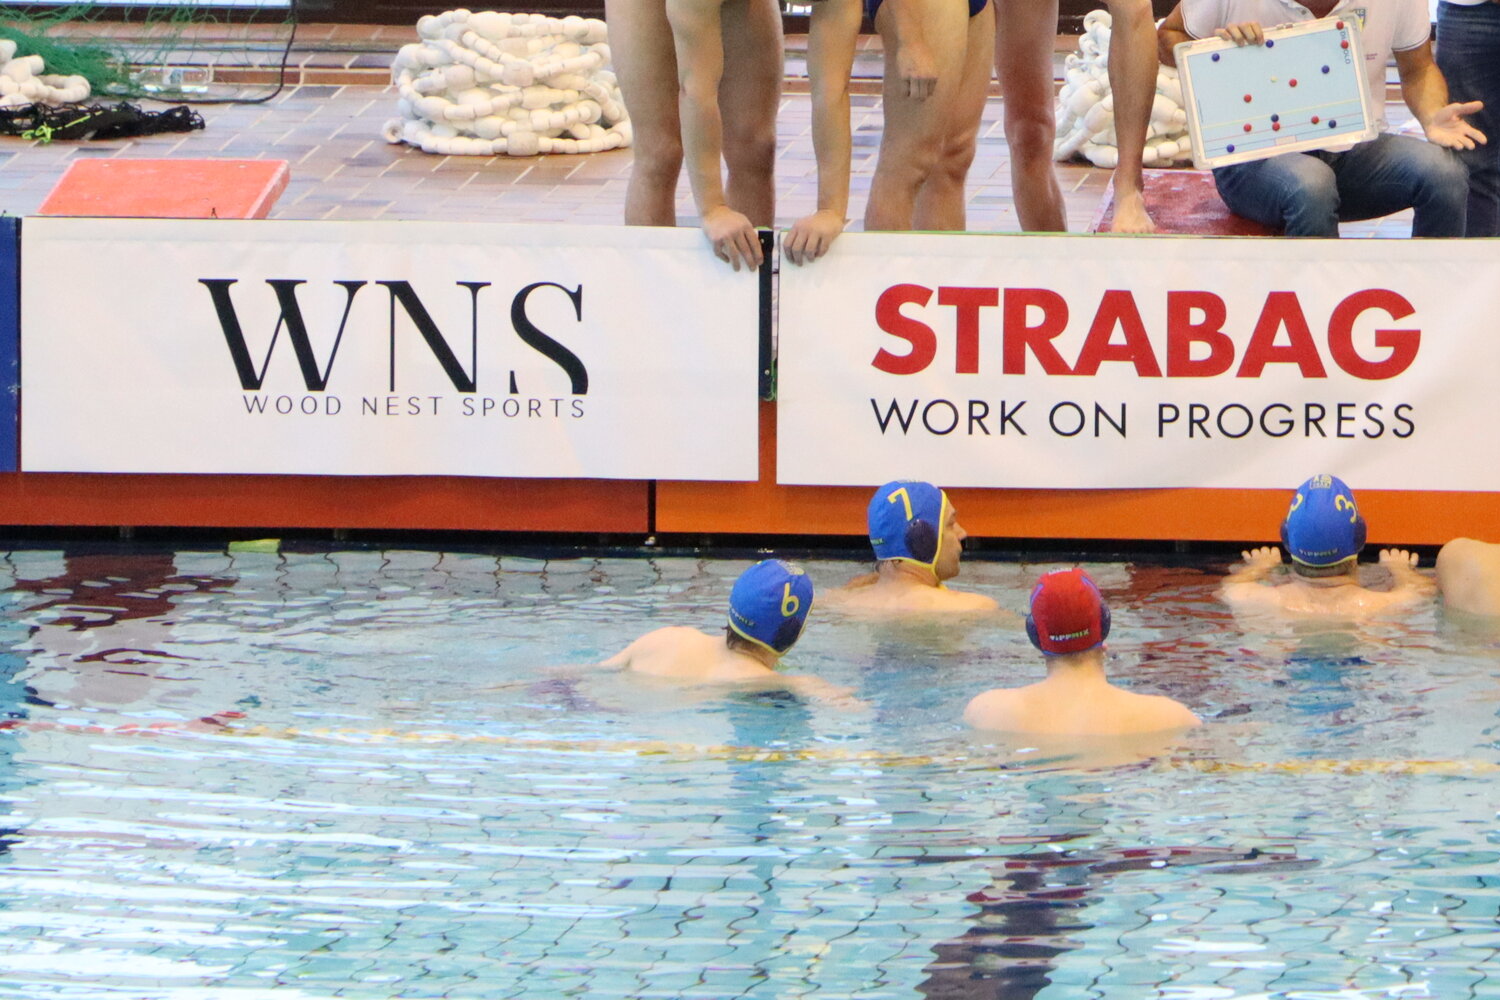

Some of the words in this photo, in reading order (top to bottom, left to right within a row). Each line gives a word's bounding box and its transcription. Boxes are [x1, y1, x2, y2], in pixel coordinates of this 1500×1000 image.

[199, 279, 589, 394] WNS
[871, 284, 1421, 380] STRABAG
[243, 394, 342, 416] WOOD
[363, 395, 443, 417] NEST
[462, 396, 586, 419] SPORTS
[870, 398, 1027, 436] WORK
[1048, 401, 1127, 438] ON
[1158, 402, 1415, 439] PROGRESS
[887, 487, 913, 521] 7
[1335, 494, 1357, 524] 3
[781, 582, 799, 617] 6
